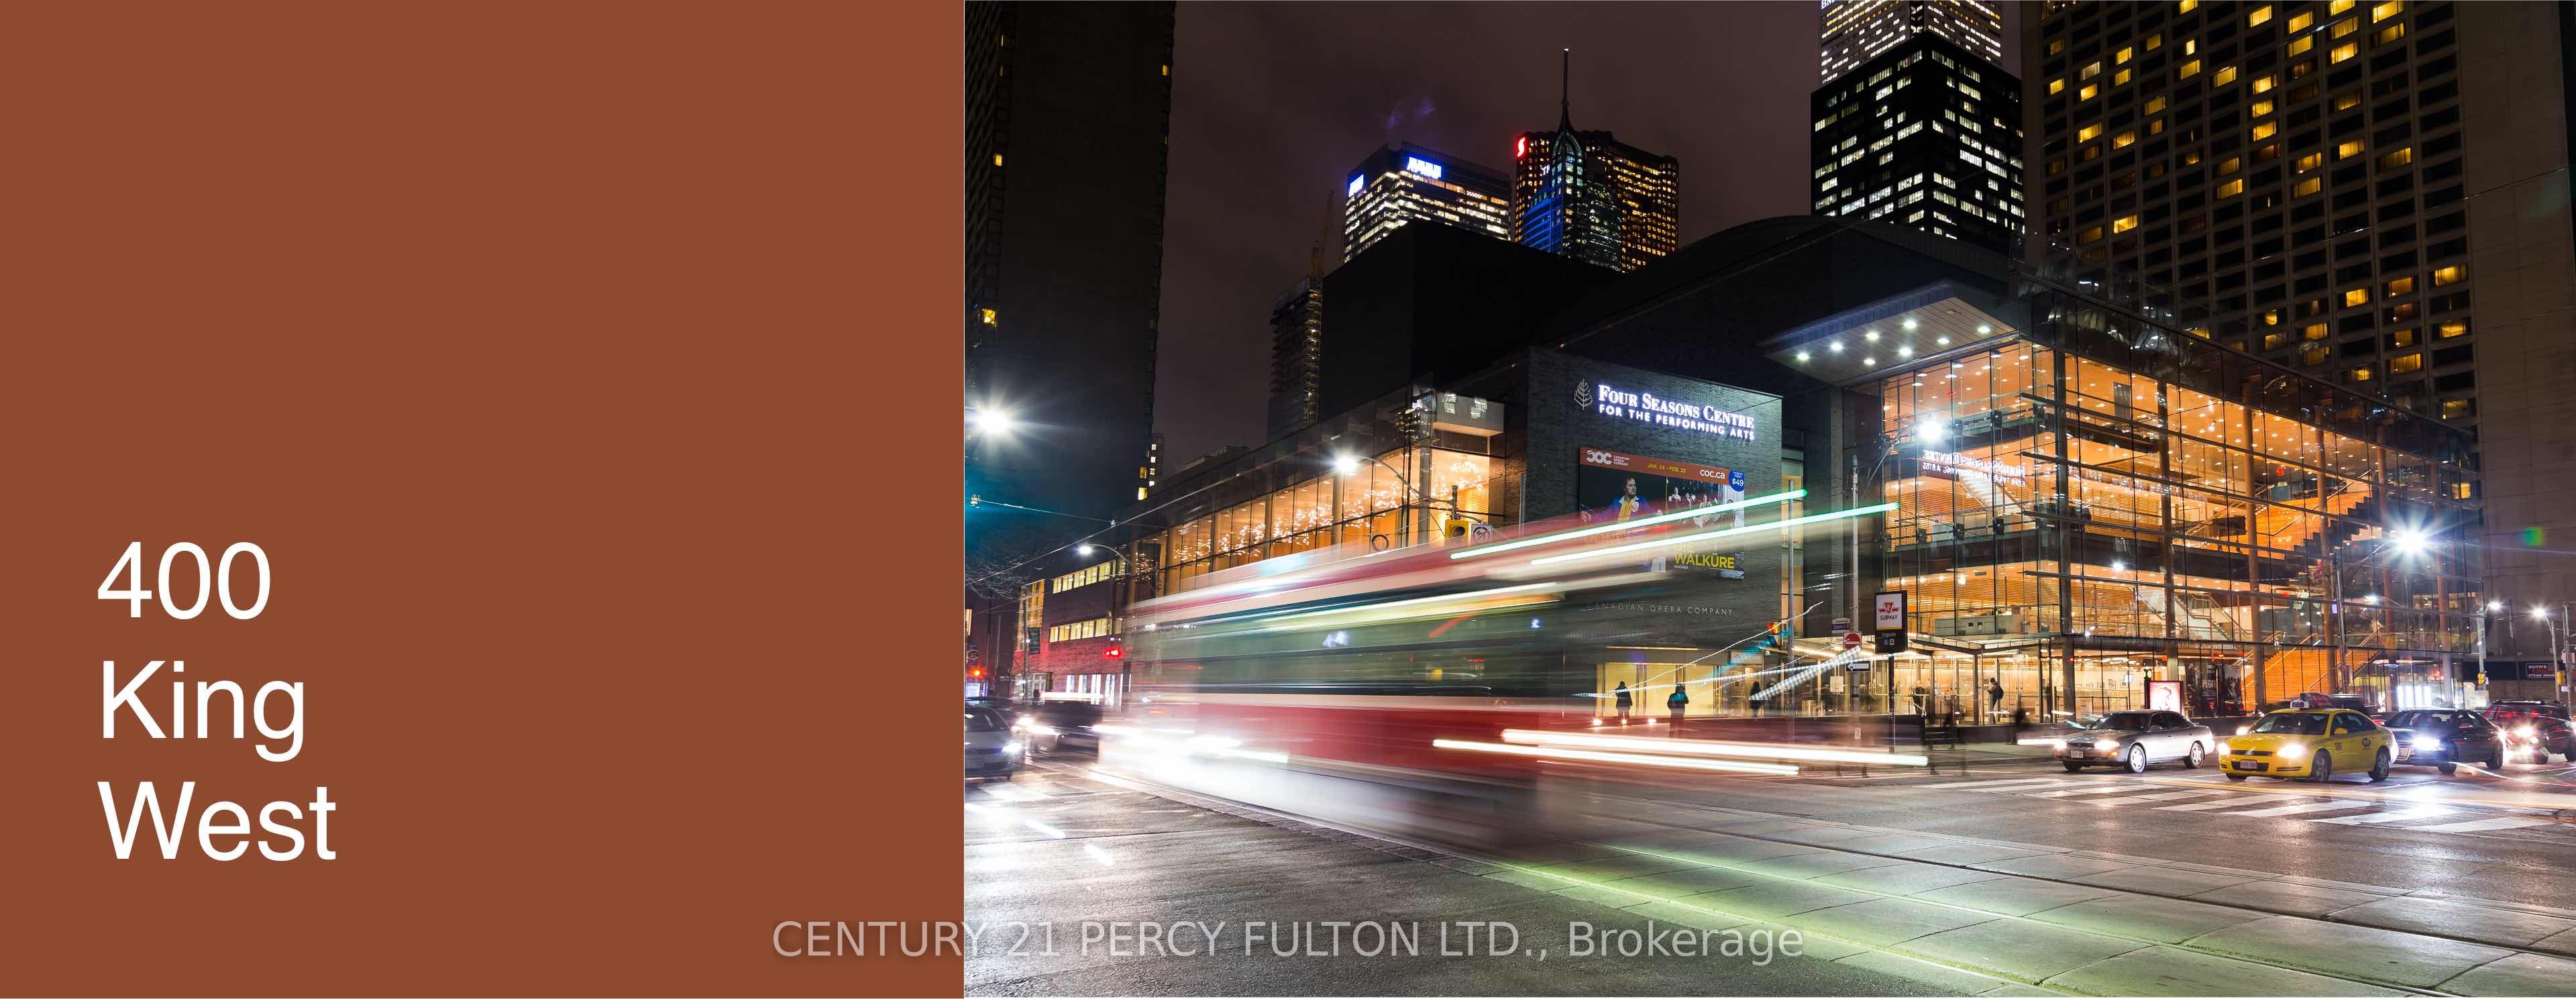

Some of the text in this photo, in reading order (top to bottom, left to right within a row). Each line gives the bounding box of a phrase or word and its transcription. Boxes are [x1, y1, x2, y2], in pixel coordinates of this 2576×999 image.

[1597, 384, 1755, 429] FOUR SEASONS CENTRE
[1599, 404, 1755, 441] FOR THE PERFORMING ARTS
[1699, 469, 1726, 480] coc.ca
[1731, 478, 1744, 486] $49
[1674, 552, 1735, 570] WALKÜRE
[1650, 604, 1682, 613] OPERA
[1687, 607, 1734, 615] COMPANY
